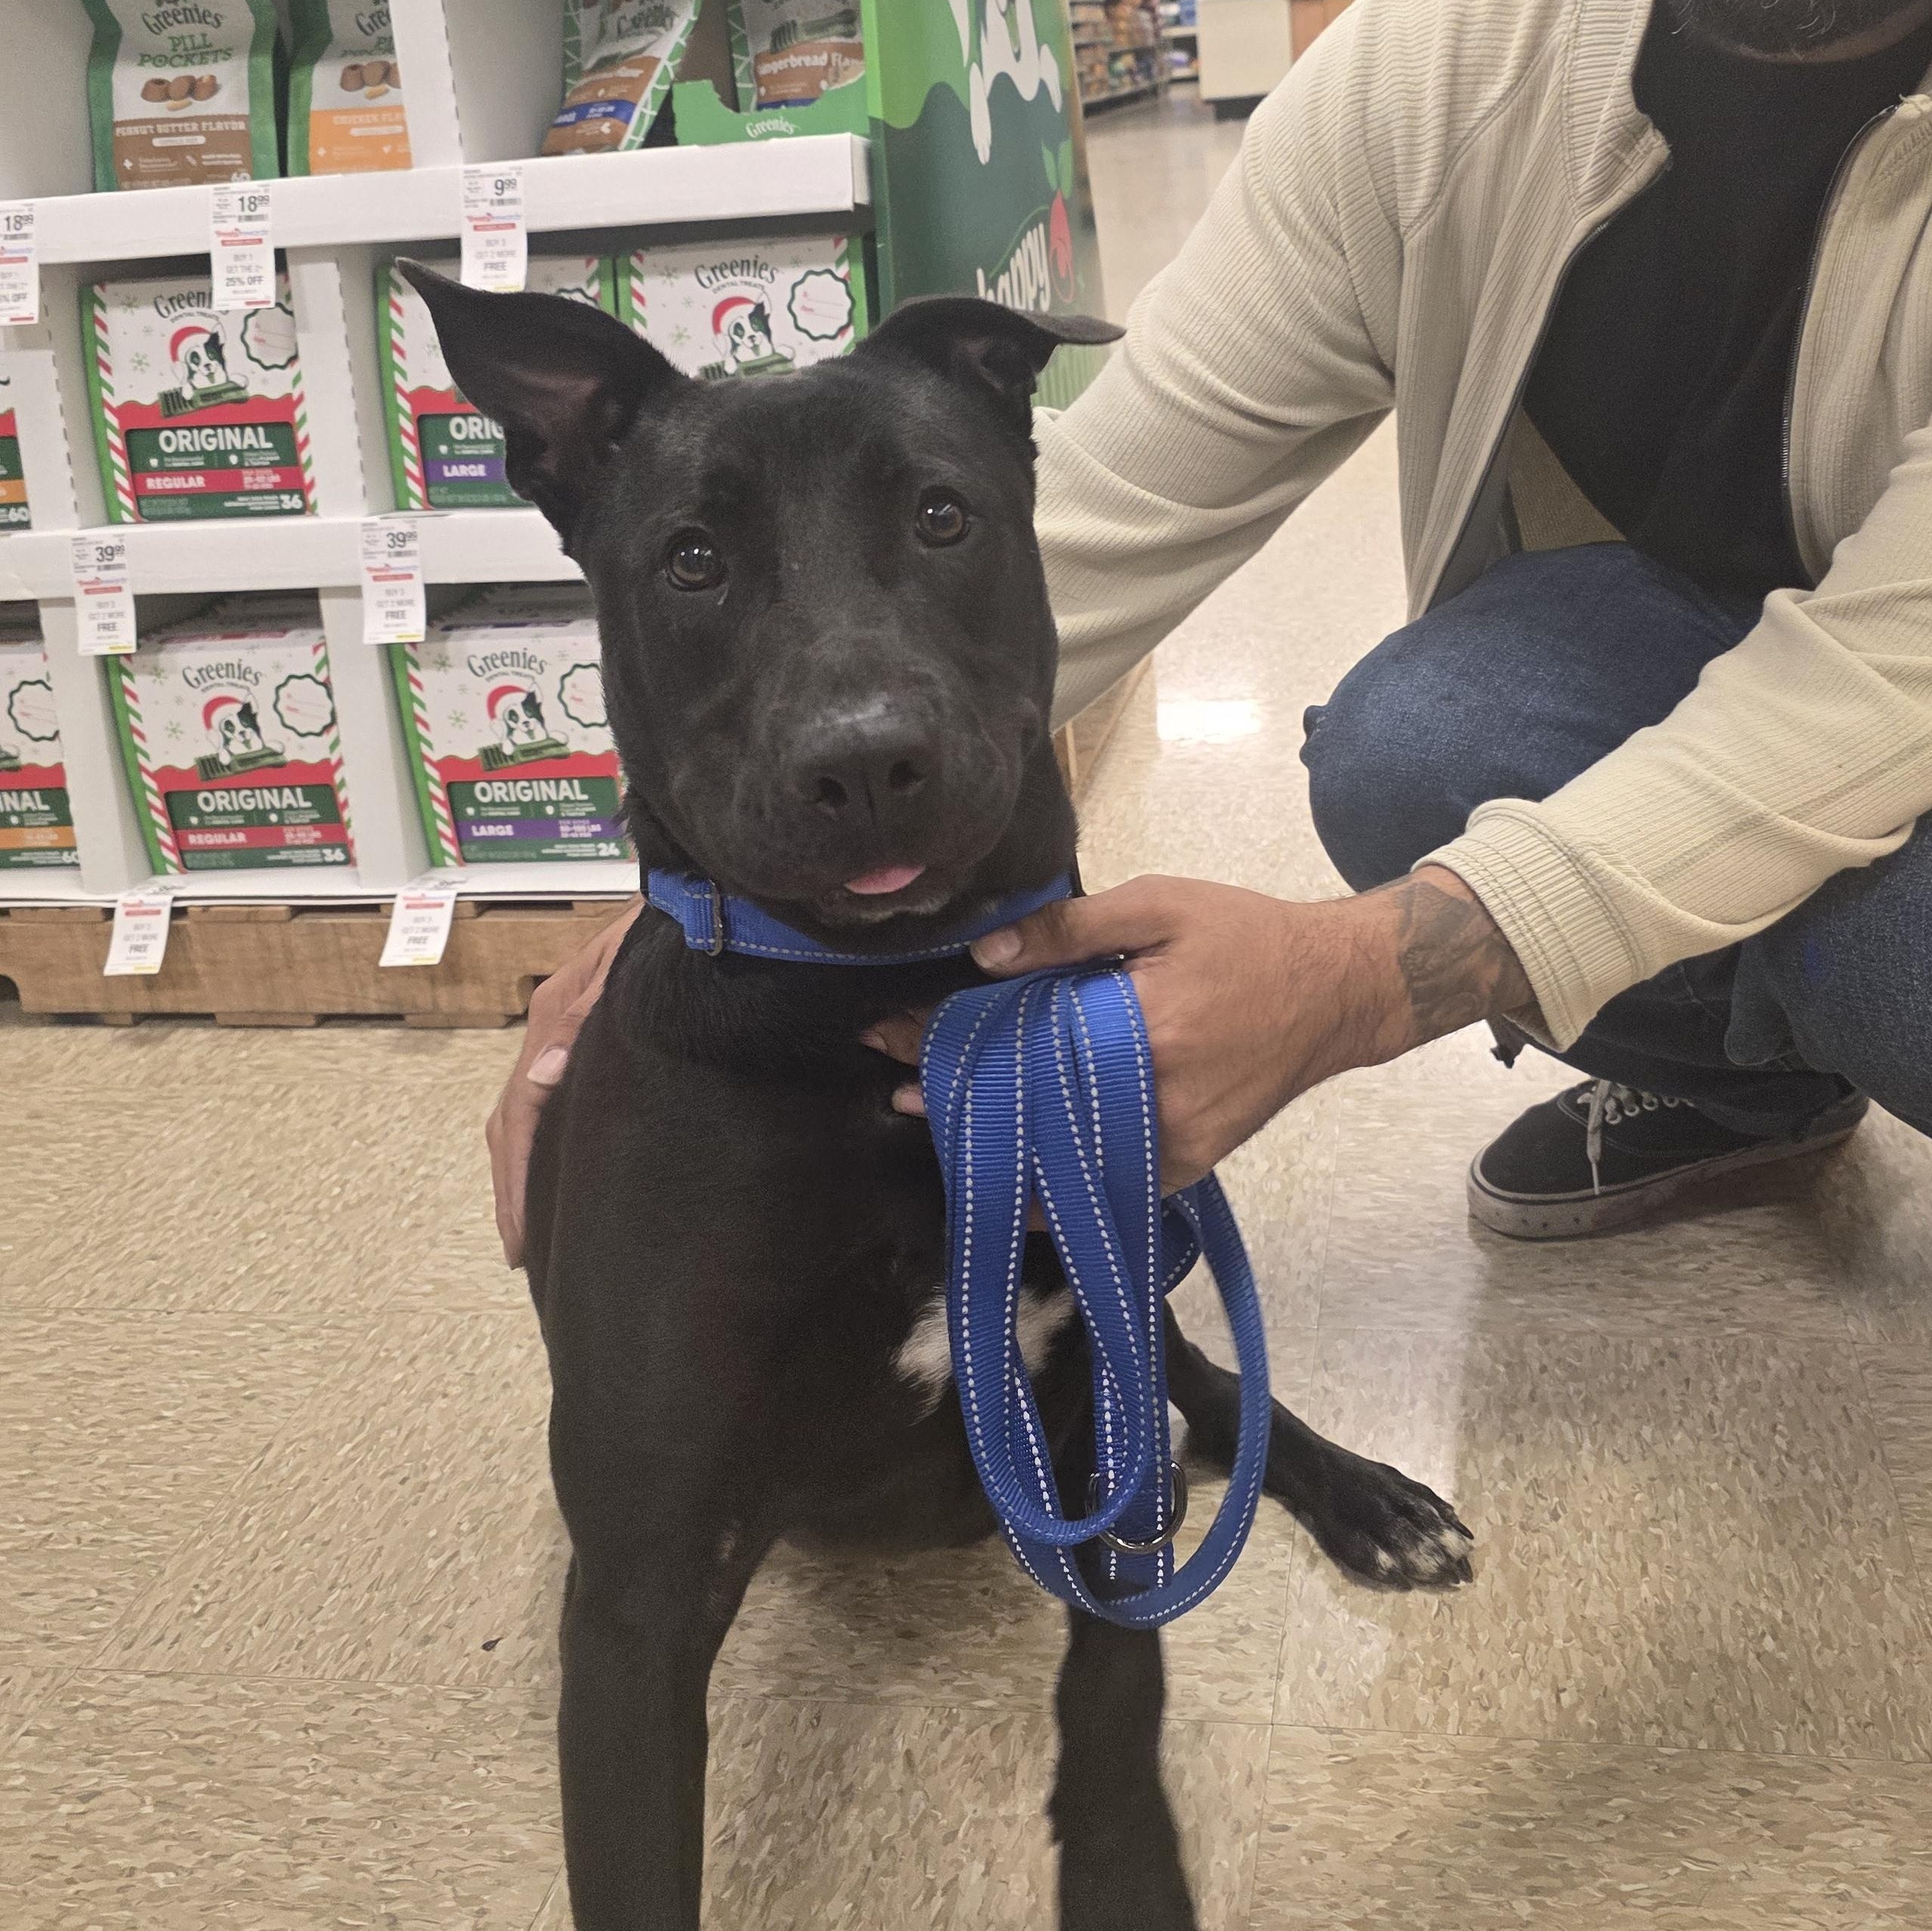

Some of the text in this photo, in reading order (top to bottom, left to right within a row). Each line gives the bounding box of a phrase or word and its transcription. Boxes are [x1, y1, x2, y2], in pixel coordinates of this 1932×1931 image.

[141, 4, 224, 36] Greenies
[168, 32, 213, 52] PILL
[138, 47, 233, 68] POCKETS
[484, 261, 507, 271] FREE
[694, 255, 779, 289] Greenies
[225, 276, 264, 287] 25% OFF
[153, 288, 229, 319] Greeni
[450, 416, 505, 440] ORIG
[158, 426, 274, 453] ORIGINAL
[443, 464, 487, 477] LARGE
[145, 474, 206, 490] REGULAR
[280, 495, 303, 510] 36
[385, 610, 406, 620] FREE
[97, 623, 117, 632] FREE
[467, 647, 549, 678] Greenies
[182, 659, 263, 689] Greenies
[474, 780, 589, 802] ORIGINAL
[197, 787, 312, 813] ORIGINAL
[471, 824, 515, 837] LARGE
[188, 833, 247, 845] REGULAR
[322, 848, 346, 862] 36
[596, 842, 620, 857] 24
[407, 936, 430, 944] FREE
[128, 944, 150, 953] FREE
